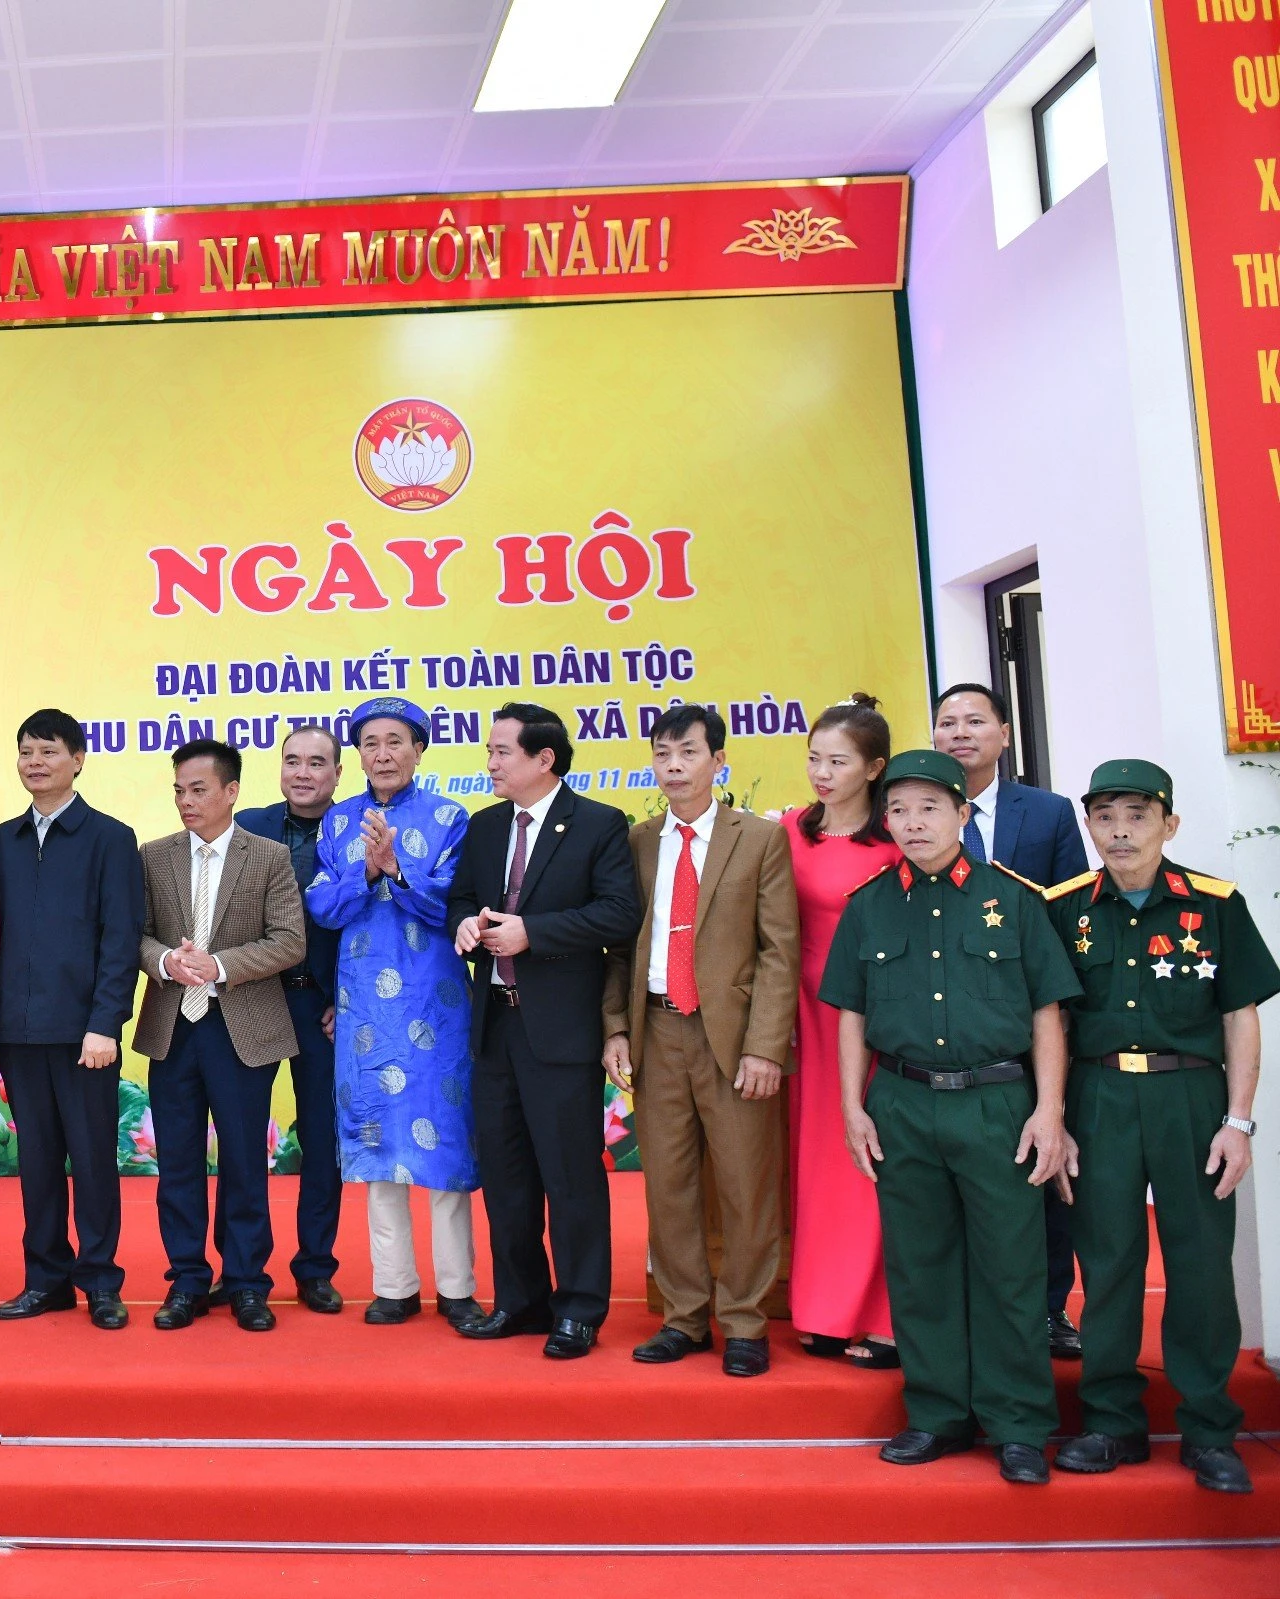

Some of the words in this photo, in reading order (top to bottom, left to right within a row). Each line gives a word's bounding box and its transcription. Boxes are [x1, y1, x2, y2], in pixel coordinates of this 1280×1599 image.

[1233, 54, 1280, 114] QU
[52, 224, 179, 311] VIỆT
[199, 233, 321, 293] NAM
[342, 207, 506, 286] MUÔN
[521, 204, 670, 278] NĂM!
[1232, 252, 1280, 308] TH
[367, 418, 383, 437] MẶT
[384, 407, 408, 420] TRẬN
[416, 405, 429, 414] TỔ
[430, 409, 453, 429] QUỐC
[390, 490, 414, 503] VIỆT
[416, 489, 440, 501] NAM
[149, 521, 464, 614] NGÀY
[495, 509, 696, 622] HỘI
[156, 663, 217, 702] ĐẠI
[229, 655, 330, 694] ĐOÀN
[343, 648, 410, 691] KẾT
[422, 649, 520, 688] TOÀN
[533, 646, 610, 685] DÂN
[622, 643, 694, 688] TỘC
[79, 721, 126, 752] HU
[138, 713, 214, 751] DÂN
[227, 714, 279, 749] CƯ
[431, 706, 480, 744] ÊN
[577, 701, 628, 740] XÃ
[730, 694, 808, 735] HÒA
[599, 769, 620, 788] 11
[627, 767, 658, 788] nă
